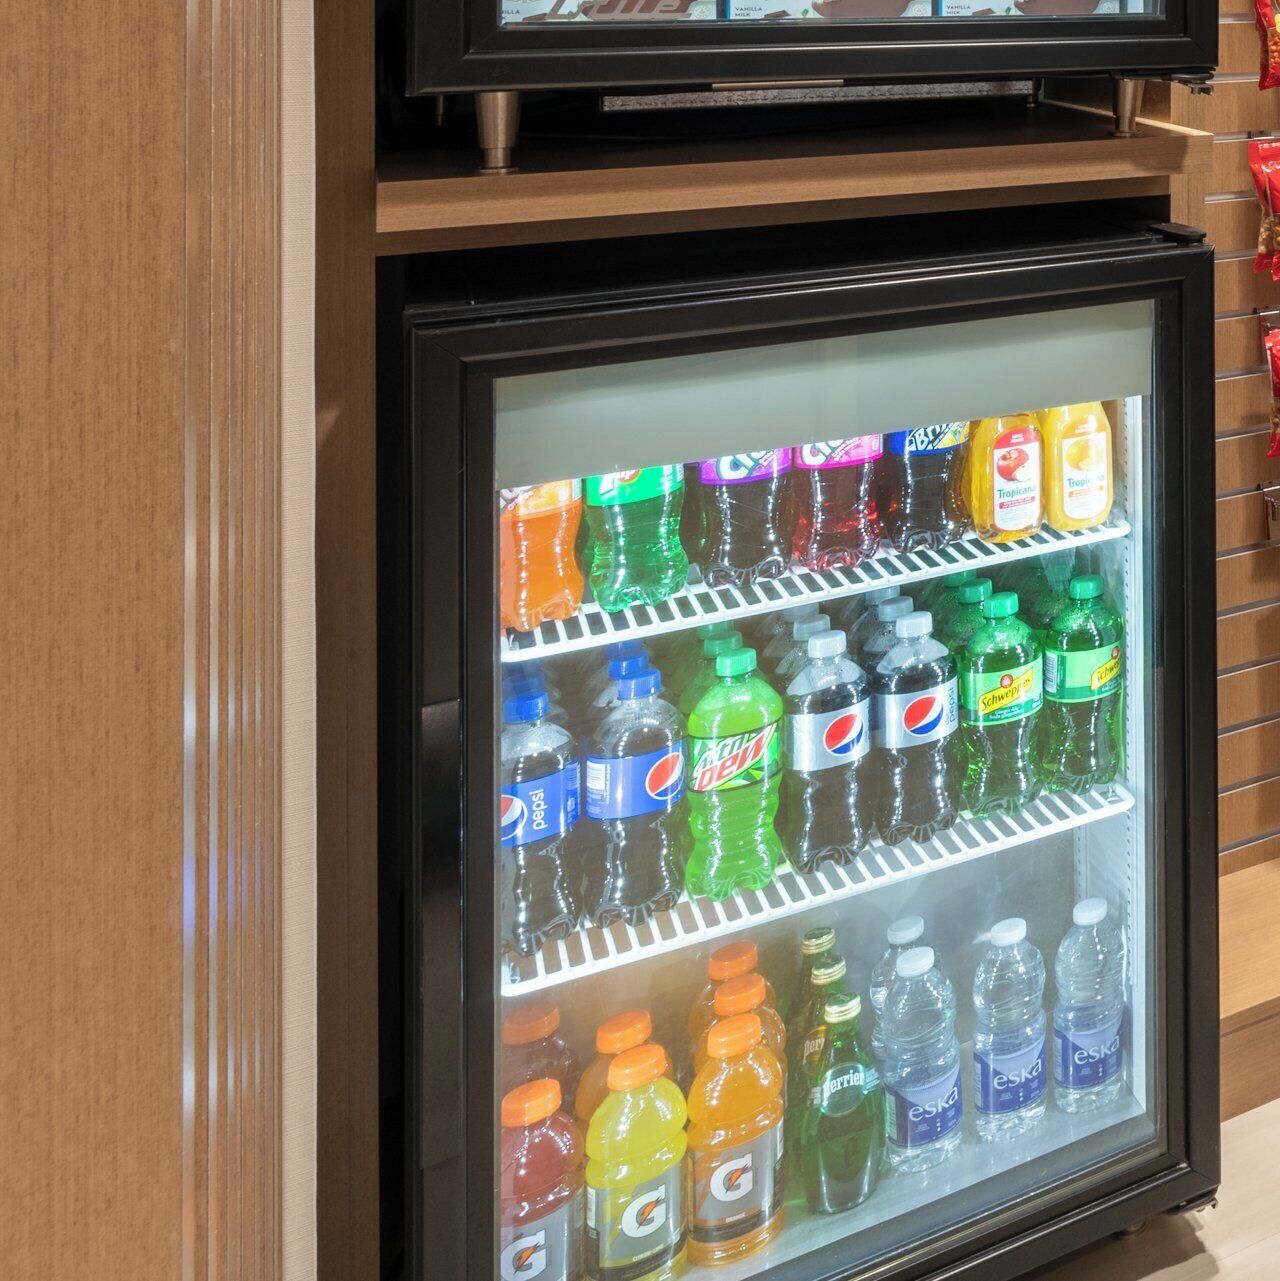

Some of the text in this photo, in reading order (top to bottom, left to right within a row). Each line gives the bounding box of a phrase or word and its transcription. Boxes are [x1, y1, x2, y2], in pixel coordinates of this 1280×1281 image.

[997, 485, 1037, 500] Tropicana
[531, 786, 547, 832] pepsi
[1074, 1034, 1120, 1065] eska
[993, 1058, 1042, 1090] eska
[908, 1086, 958, 1122] eska
[709, 1153, 753, 1202] G
[621, 1183, 666, 1238] G
